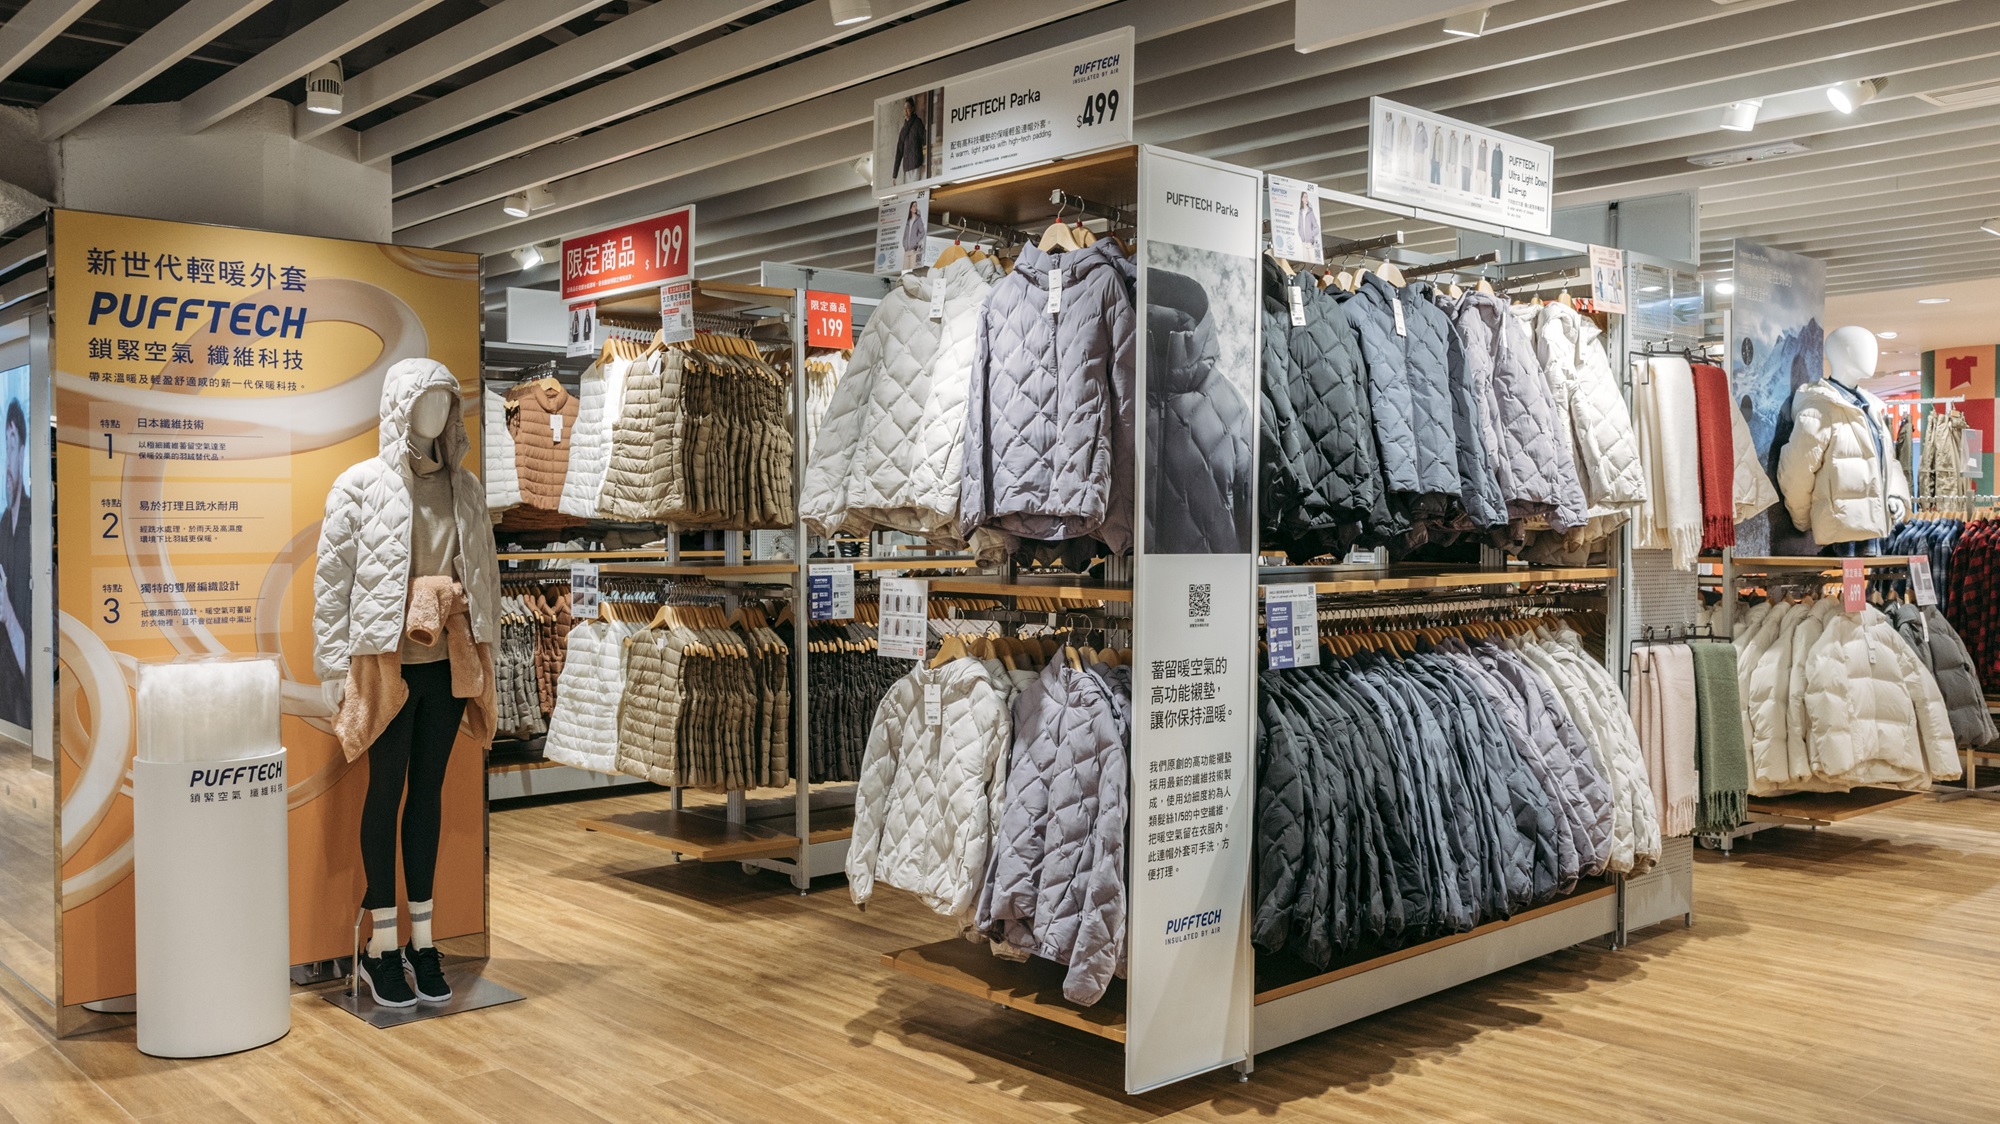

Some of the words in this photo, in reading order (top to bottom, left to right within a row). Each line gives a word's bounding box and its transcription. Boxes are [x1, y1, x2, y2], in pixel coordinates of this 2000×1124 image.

[1073, 54, 1120, 77] PUFFTECH
[1072, 73, 1100, 84] INSULATED
[951, 96, 1006, 123] PUFFTECH
[1010, 88, 1041, 109] Parka
[1076, 89, 1119, 129] $499
[971, 146, 981, 156] light
[982, 143, 996, 152] parka
[997, 140, 1008, 148] with
[1008, 134, 1032, 147] high-tech
[1508, 155, 1536, 171] PUFFTECH
[1508, 170, 1521, 182] Ultra
[1521, 173, 1534, 186] Light
[1535, 176, 1548, 188] Down
[1508, 184, 1528, 199] Line-up
[1166, 191, 1213, 212] PUFFTECH
[1215, 201, 1239, 218] Parka
[566, 235, 635, 281] 限定商品
[87, 247, 307, 293] 新世代輕暖外套
[88, 291, 308, 339] PUFFTECH
[810, 299, 847, 314] 限定商品
[88, 337, 194, 364] 鎖緊空氣
[207, 345, 303, 371] 纖維科技
[100, 419, 121, 429] 特點
[137, 418, 204, 430] 日本纖維技術
[104, 433, 113, 460] 1
[101, 498, 122, 508] 特點
[139, 501, 239, 512] 易於打理且跣水耐用
[102, 512, 119, 539] 2
[102, 584, 123, 594] 特點
[140, 581, 240, 594] 獨特的雙層編織設計
[103, 597, 121, 624] 3
[1151, 656, 1228, 680] 蓄留暖空氣的
[1150, 681, 1221, 705] 高功能襯墊，
[1150, 704, 1233, 730] 讓你保持溫暖。
[190, 760, 283, 788] PUFFTECH
[1149, 751, 1232, 774] 我們原創的高功能襯墊
[1149, 768, 1232, 791] 採用最新的纖維技術製
[190, 790, 241, 803] 鎖緊空氣
[1148, 786, 1232, 809] 成，使用幼細度約為人
[1148, 804, 1229, 827] 類髮絲1/5的中空纖維，
[1148, 822, 1229, 846] 把暖空氣留在衣服內。
[1147, 837, 1230, 863] 此連帽外套可手洗，方
[1147, 865, 1179, 881] 便打理。
[1165, 908, 1222, 935] PUFFTECH
[1164, 931, 1198, 945] INSULATED
[1200, 929, 1209, 937] BY
[1210, 926, 1221, 935] AIR
